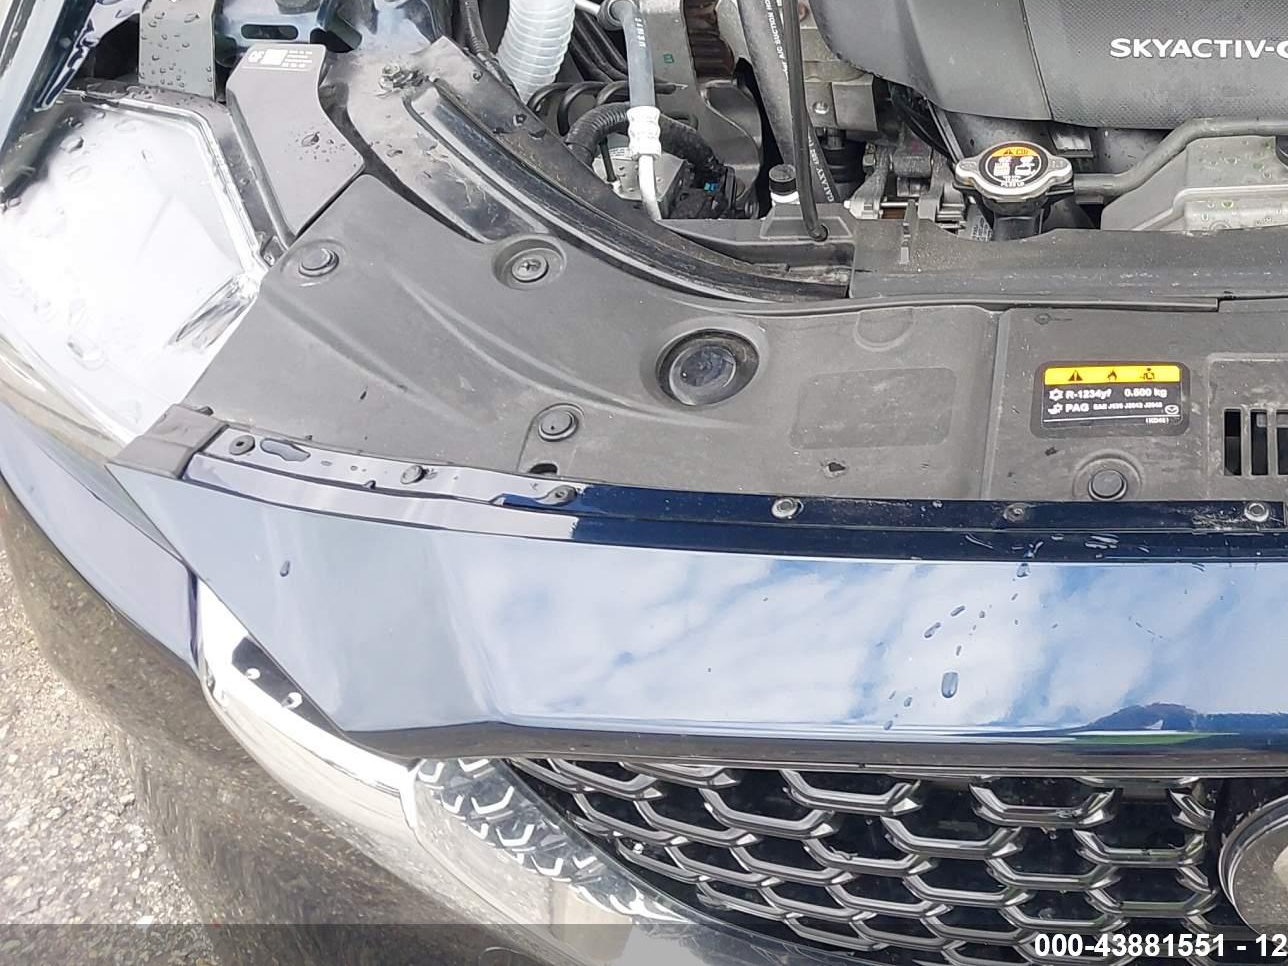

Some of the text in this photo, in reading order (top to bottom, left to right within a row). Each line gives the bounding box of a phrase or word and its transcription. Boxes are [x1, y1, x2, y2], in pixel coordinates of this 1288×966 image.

[768, 12, 781, 45] SUCTION
[816, 166, 835, 203] GALAXY
[1065, 388, 1112, 400] R-1234yf
[1153, 387, 1168, 399] kg
[1065, 403, 1090, 413] PAG
